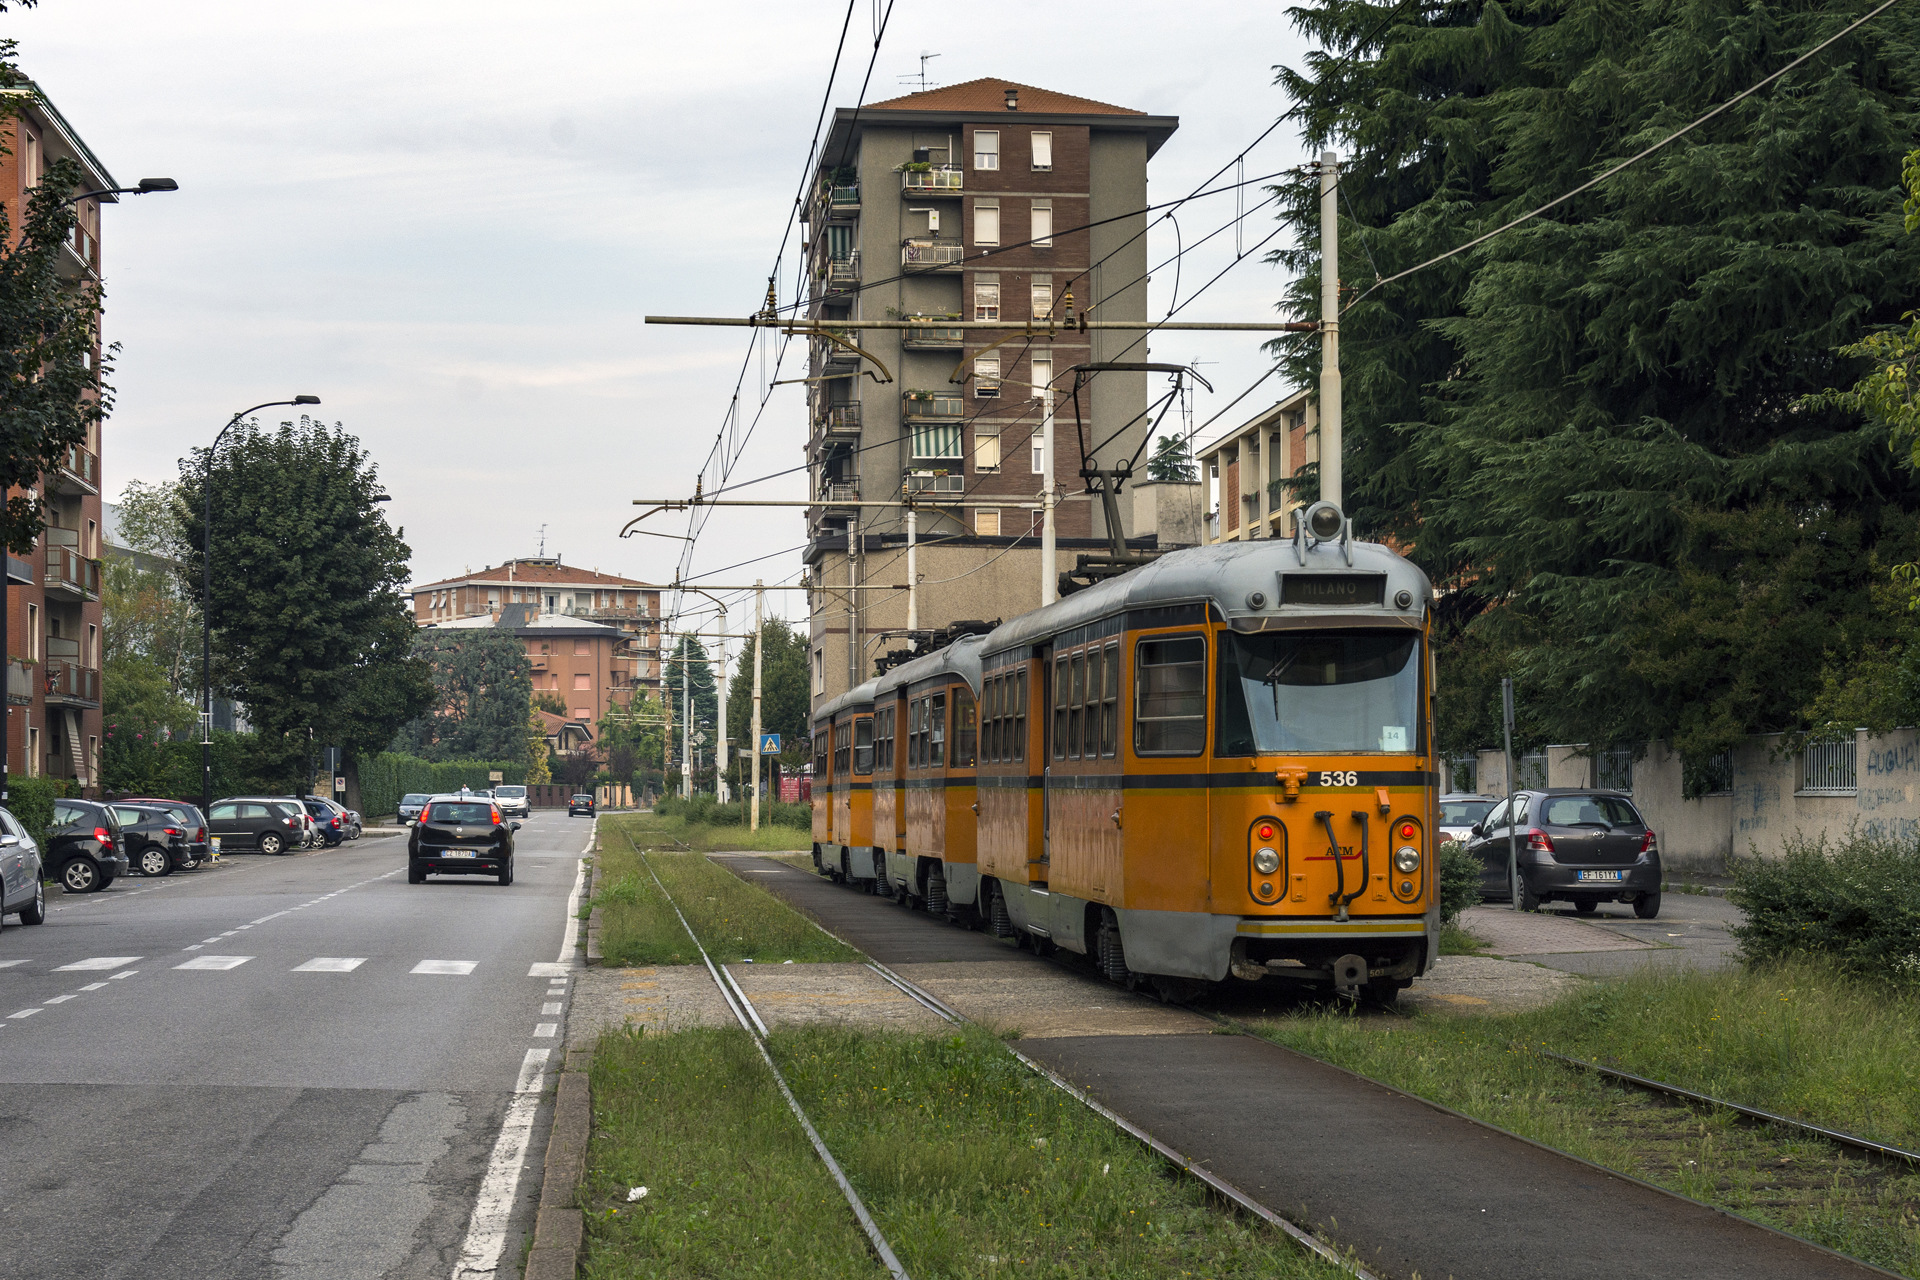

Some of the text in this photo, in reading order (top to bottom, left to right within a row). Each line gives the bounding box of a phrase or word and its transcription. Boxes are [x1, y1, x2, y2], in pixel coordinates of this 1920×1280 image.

[1302, 582, 1356, 595] MILANO
[1387, 732, 1399, 740] 14
[1319, 771, 1358, 787] 536
